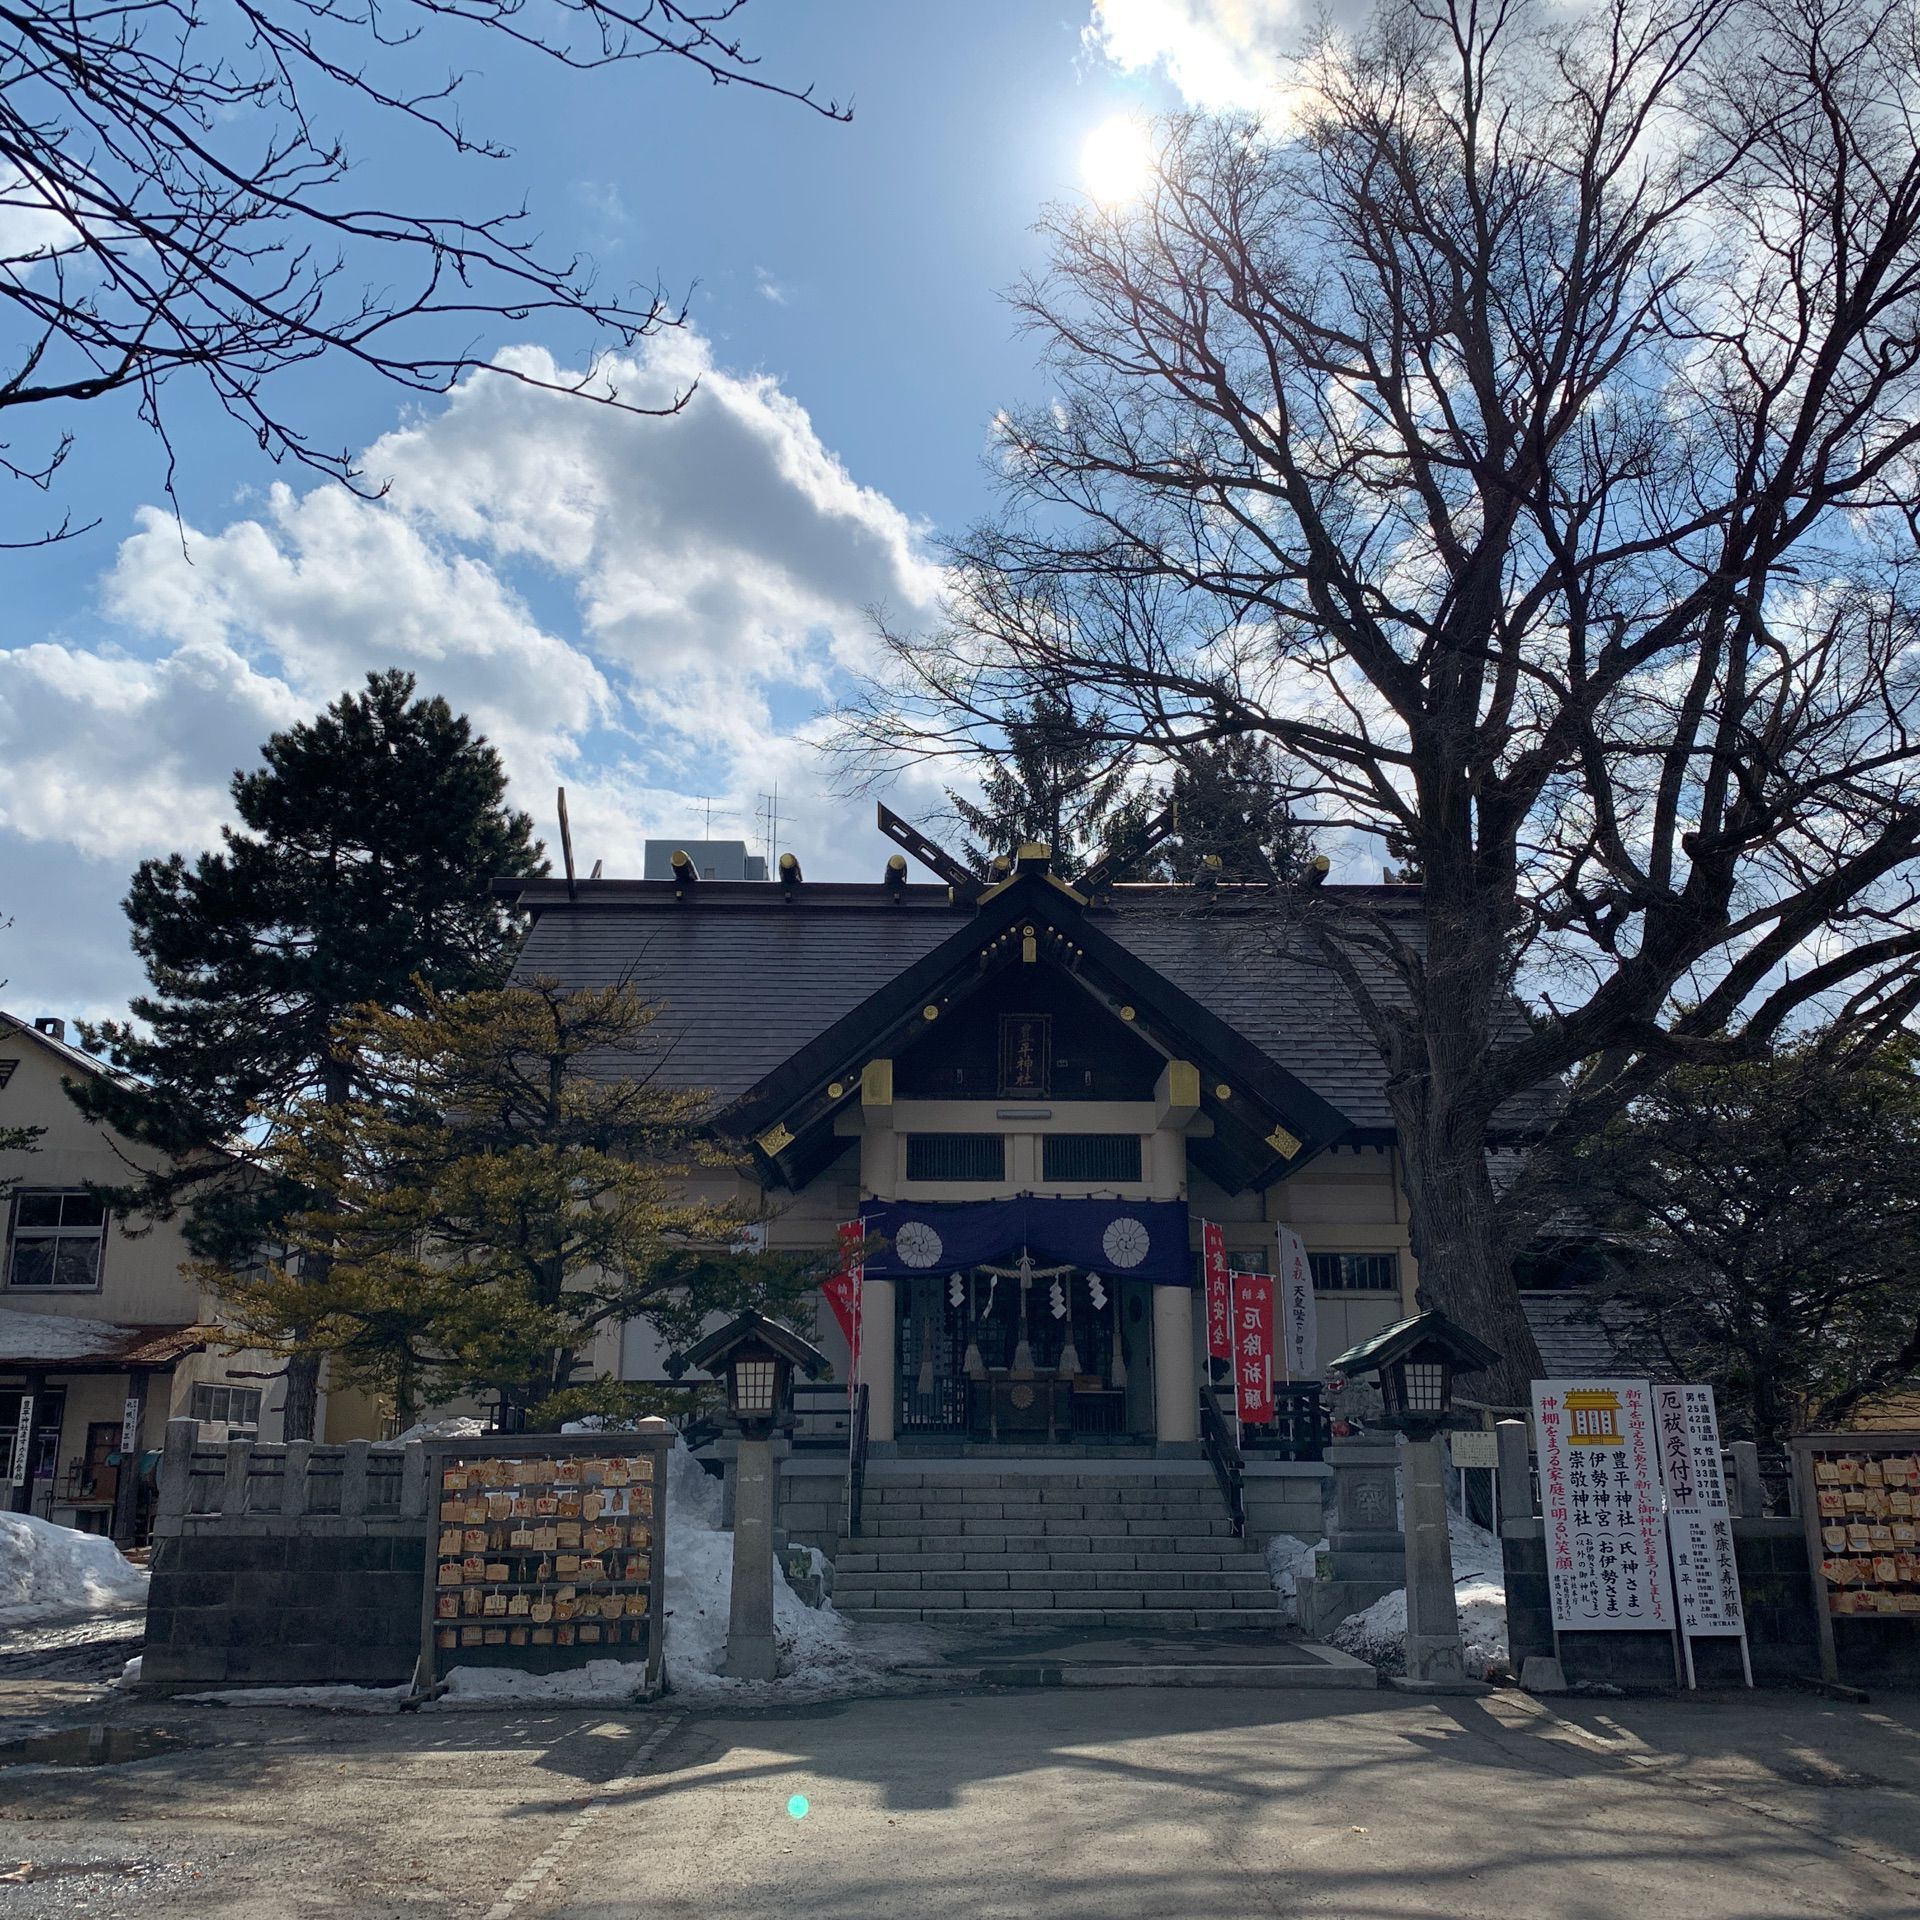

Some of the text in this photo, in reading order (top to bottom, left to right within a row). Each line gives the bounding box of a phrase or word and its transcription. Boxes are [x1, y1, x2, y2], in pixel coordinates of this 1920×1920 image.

[1686, 1392, 1707, 1402] 男性
[1687, 1405, 1709, 1413] 25歳
[1689, 1415, 1711, 1423] 42歳
[1690, 1426, 1712, 1434] 61歳
[1661, 1390, 1693, 1505] 厄祓受付中
[1693, 1447, 1714, 1456] 女性
[1694, 1459, 1716, 1467] 19歳
[1696, 1470, 1718, 1478] 33歳
[1540, 1396, 1573, 1571] 神棚をまつる家庭に明るい笑顔
[1697, 1480, 1719, 1489] 37歳
[1699, 1491, 1721, 1499] 61歳
[1713, 1520, 1740, 1618] 健康長寿祈願
[1678, 1552, 1698, 1628] 豊平神社
